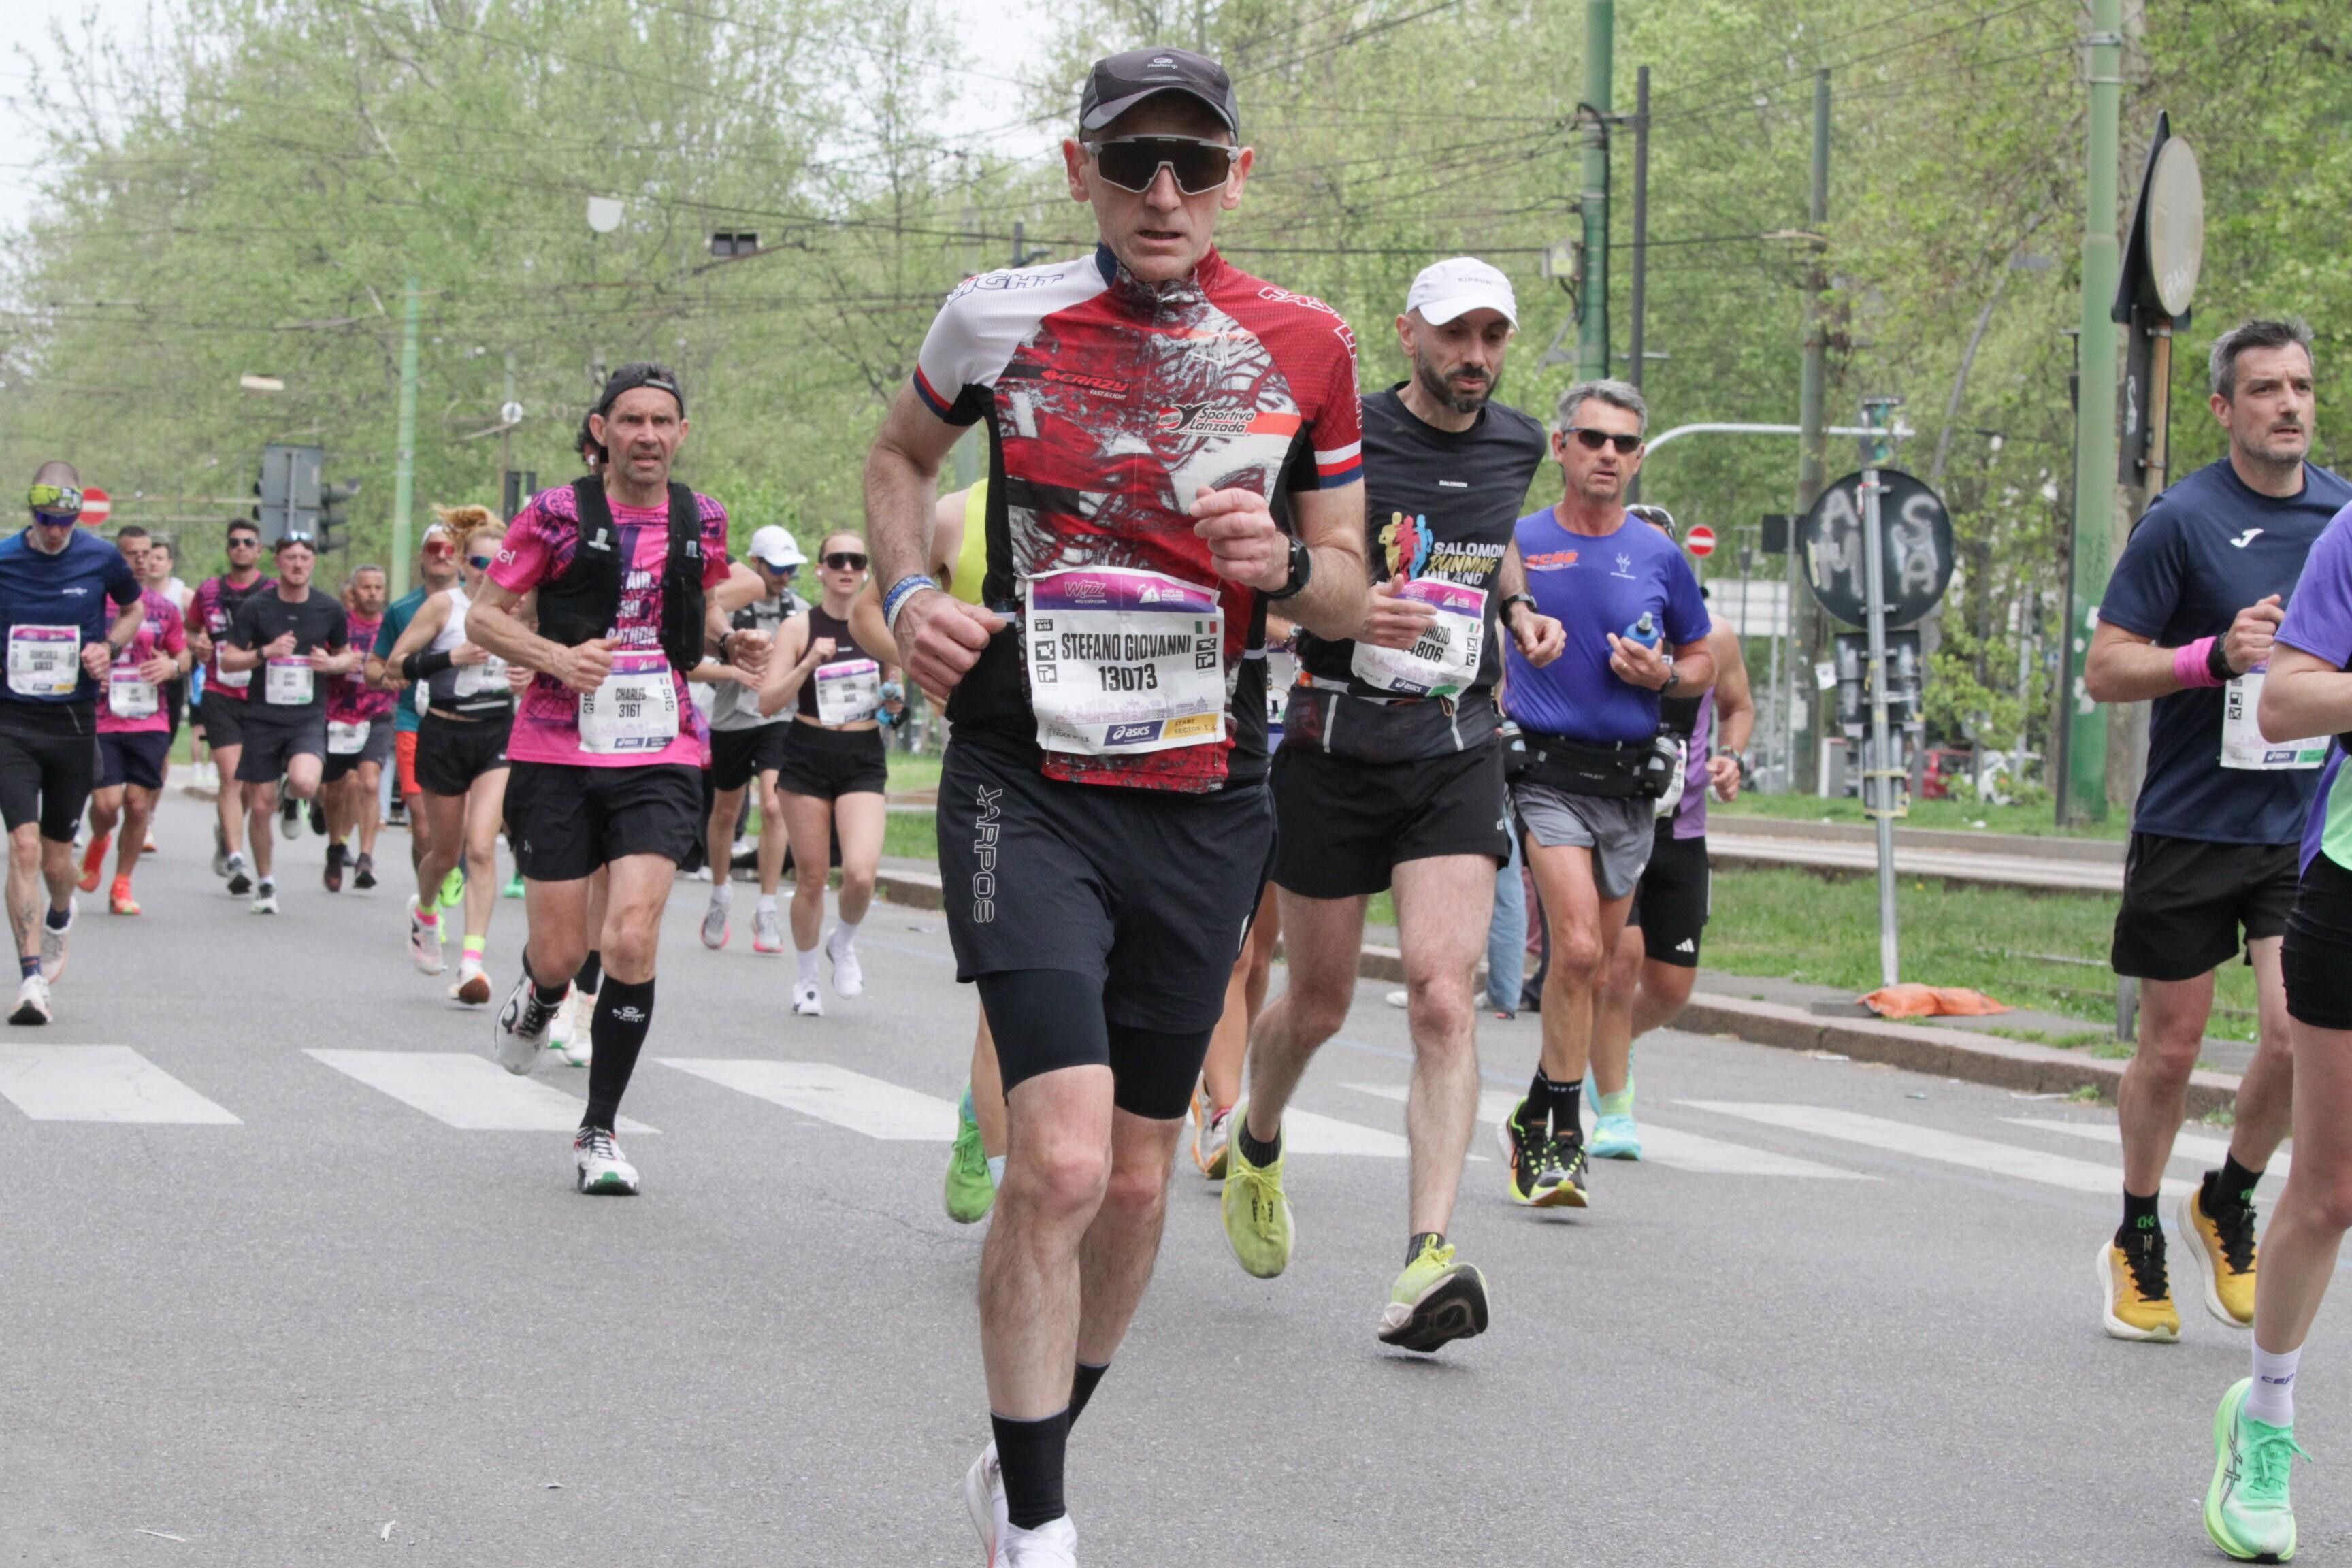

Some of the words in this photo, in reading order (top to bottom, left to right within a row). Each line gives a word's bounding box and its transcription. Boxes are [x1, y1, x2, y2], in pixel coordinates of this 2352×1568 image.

[1057, 372, 1130, 392] CRAZY
[1198, 407, 1256, 422] Sportiva
[1190, 417, 1245, 433] Lanzada
[1433, 541, 1506, 558] SALOMON
[1428, 555, 1497, 574] RUNNING
[1062, 632, 1121, 661] STEFANO
[1125, 634, 1191, 662] GIOVANNI
[1402, 640, 1444, 664] 4806
[1098, 663, 1158, 691] 13073
[619, 704, 640, 717] 3161
[973, 784, 1002, 923] KARPOS
